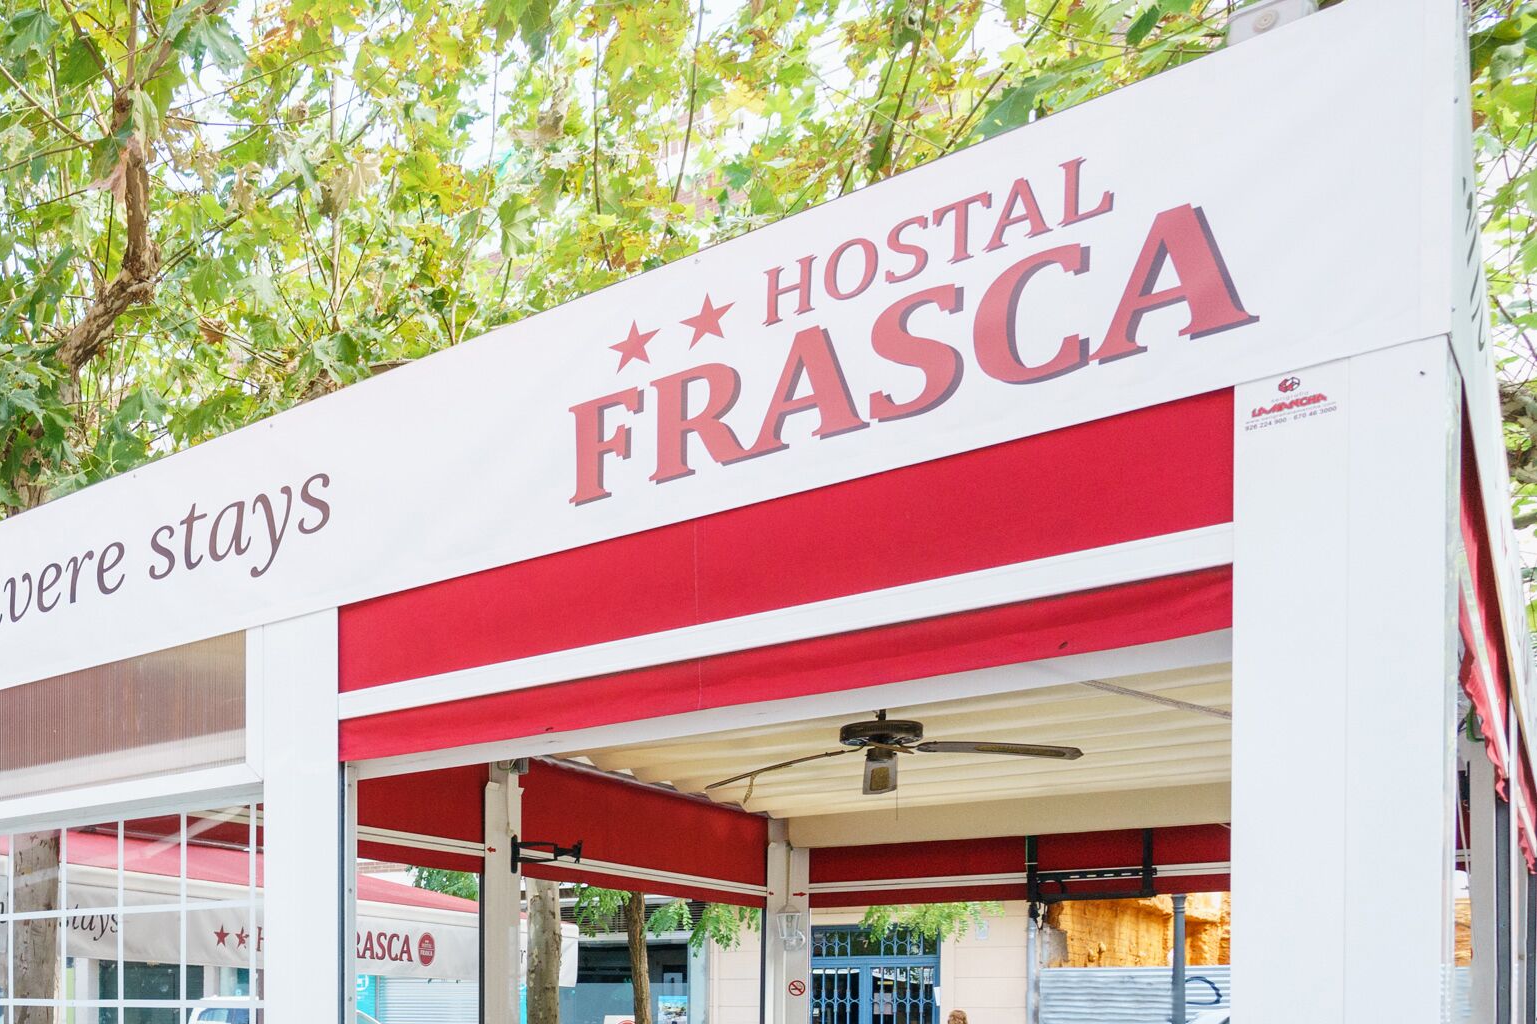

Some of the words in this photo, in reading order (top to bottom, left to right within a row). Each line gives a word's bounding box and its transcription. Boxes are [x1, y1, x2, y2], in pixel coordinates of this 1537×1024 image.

[762, 156, 1115, 327] HOSTAL
[568, 203, 1260, 507] FRASCA
[149, 473, 331, 578] stays
